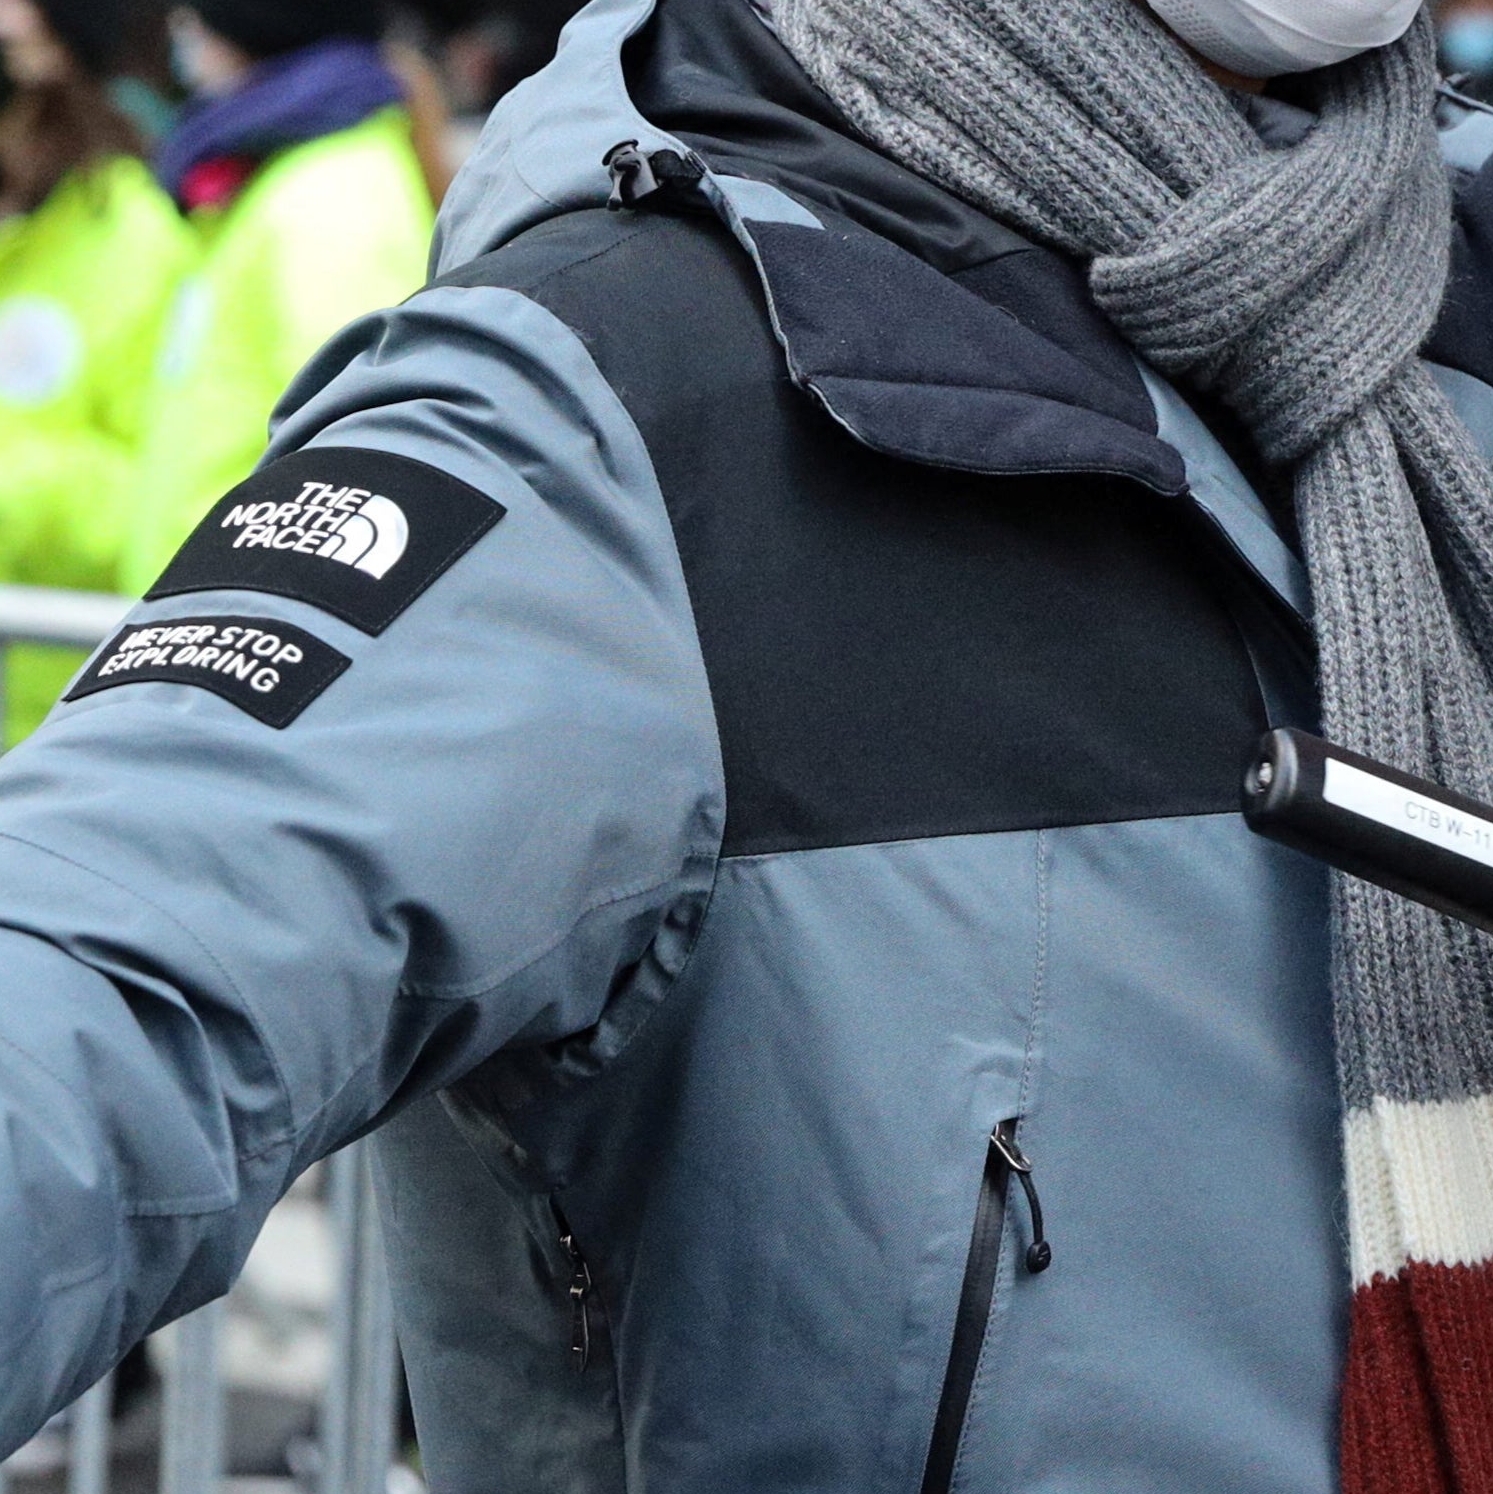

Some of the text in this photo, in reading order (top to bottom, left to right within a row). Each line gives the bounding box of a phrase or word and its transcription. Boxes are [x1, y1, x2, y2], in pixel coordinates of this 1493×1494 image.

[295, 482, 372, 512] THE
[221, 502, 350, 535] NORTH
[232, 525, 330, 554] FACE
[119, 625, 303, 664] NEVER STOP
[97, 645, 280, 693] EXPLORING
[1405, 801, 1492, 849] CTB W-11
